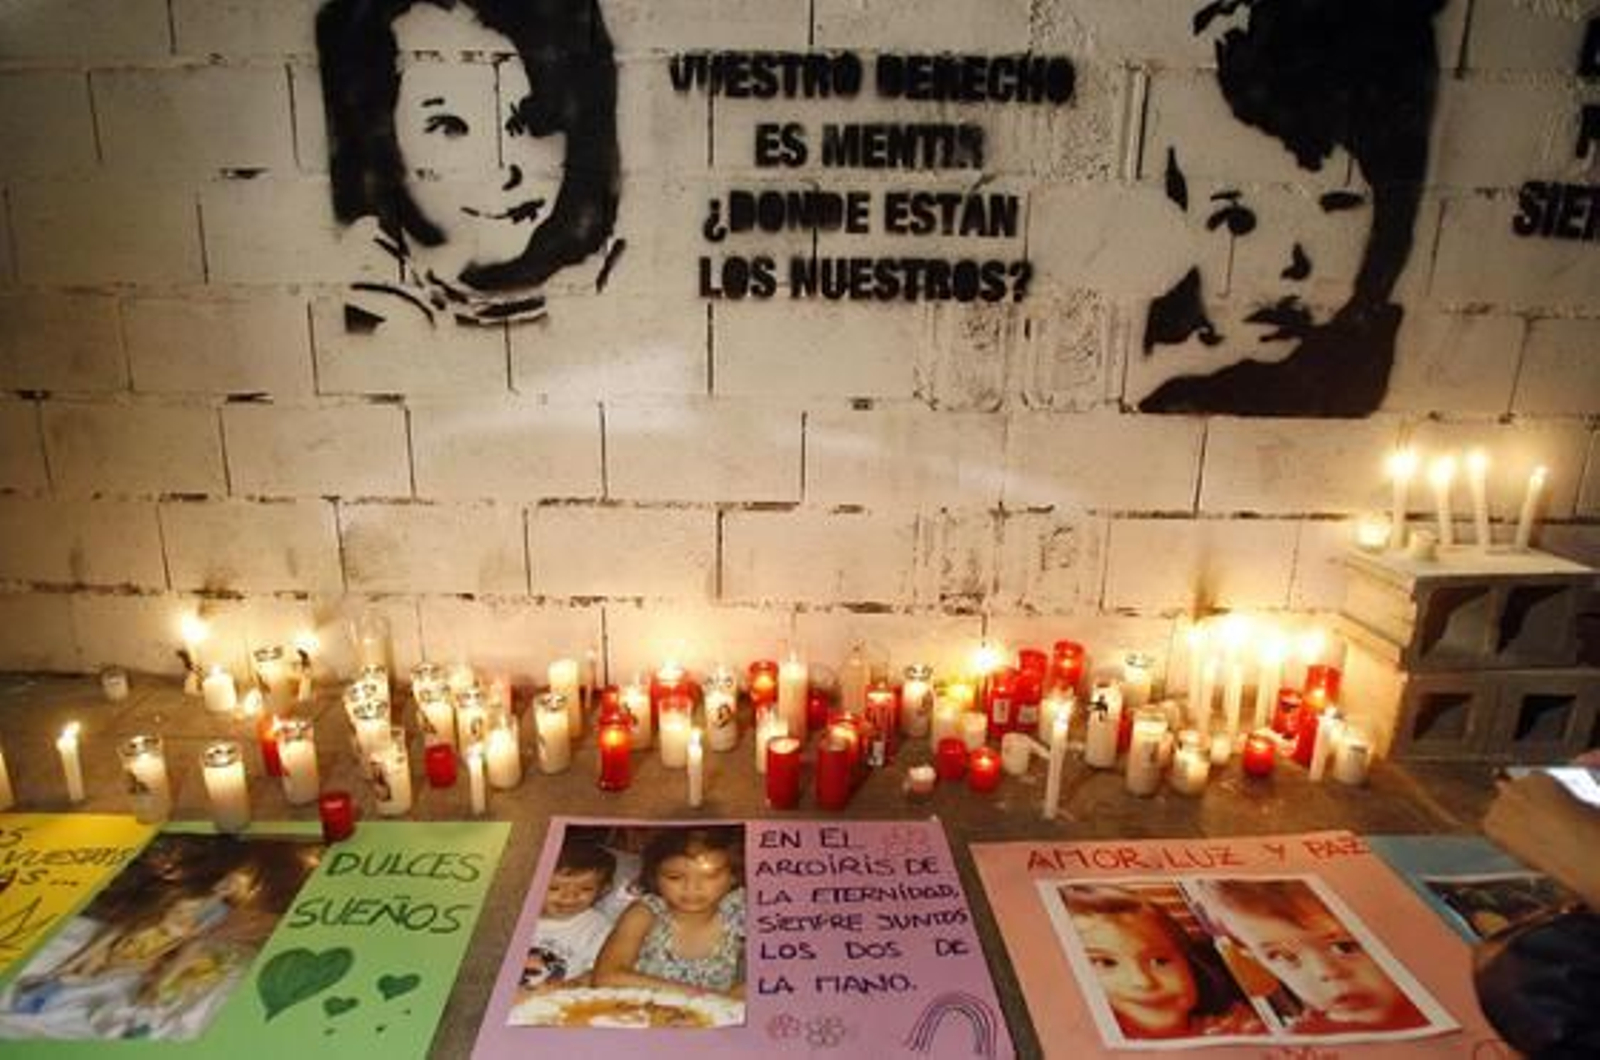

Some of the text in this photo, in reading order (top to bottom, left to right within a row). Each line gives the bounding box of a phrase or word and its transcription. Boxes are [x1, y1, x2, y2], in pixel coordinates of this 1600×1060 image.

[755, 124, 807, 168] ES
[884, 174, 1018, 237] ESTÁN
[699, 257, 1034, 303] LOS NUESTROS?
[759, 827, 865, 849] EN EL
[904, 856, 942, 875] DE
[1161, 847, 1242, 868] LUZ
[1263, 841, 1288, 862] Y
[1303, 837, 1372, 859] PAZ
[325, 852, 484, 883] DULCES
[758, 890, 792, 905] LA
[287, 895, 473, 934] SUEÑOS
[876, 907, 969, 931] JUNTOS
[760, 938, 970, 960] LOS DOS DE
[758, 976, 795, 994] LA
